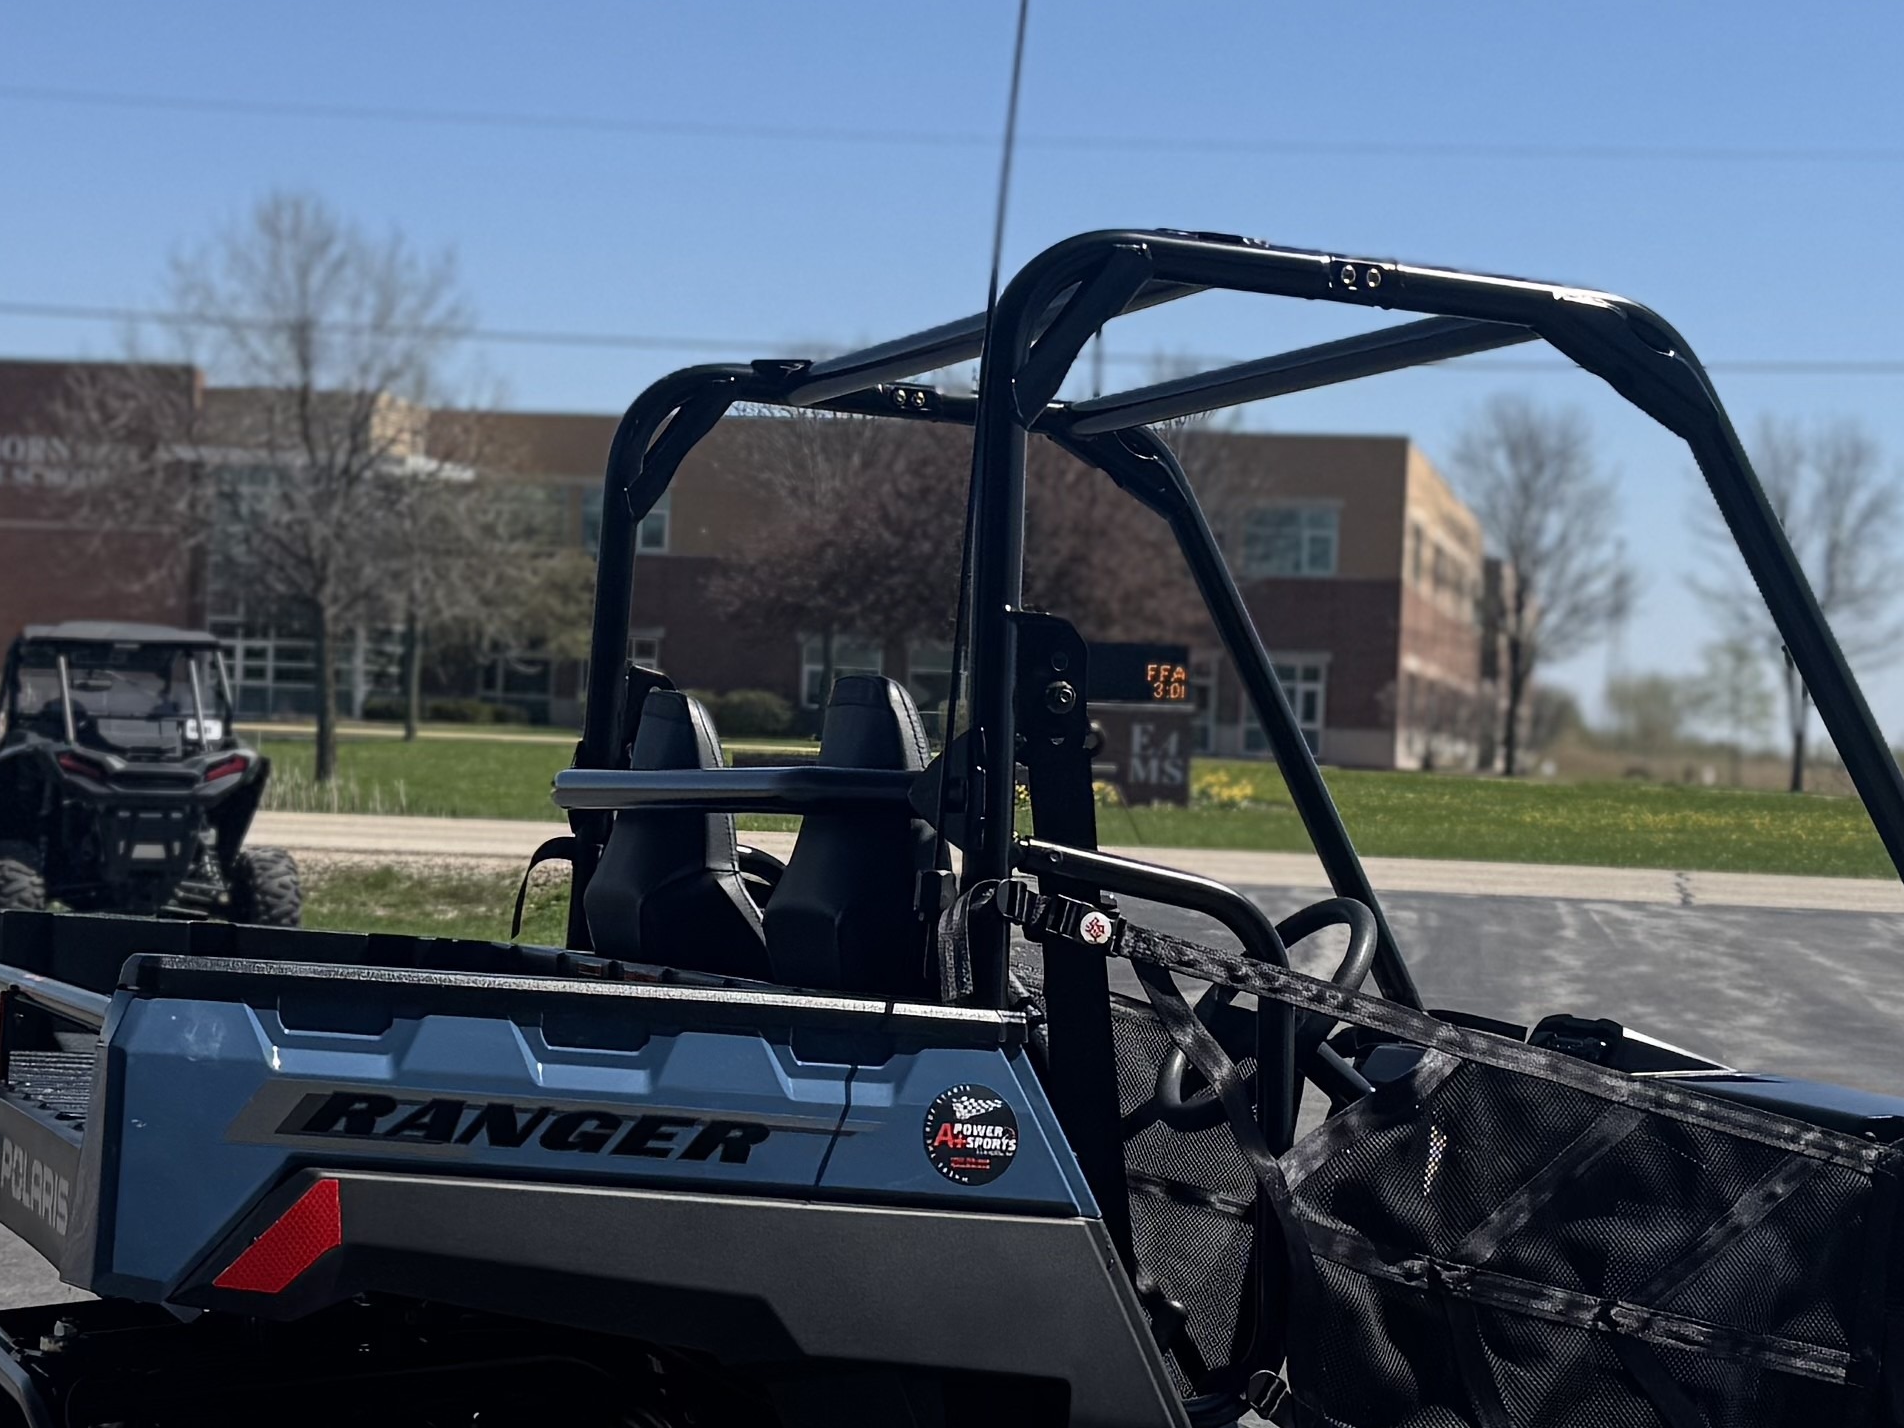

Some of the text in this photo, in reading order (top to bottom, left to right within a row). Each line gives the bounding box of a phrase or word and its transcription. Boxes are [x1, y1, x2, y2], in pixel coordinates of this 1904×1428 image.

[1147, 664, 1186, 682] FFA
[1153, 681, 1186, 699] 3:01
[1128, 756, 1184, 785] MS
[301, 1090, 770, 1165] RANGER
[934, 1122, 1005, 1149] A+ POWER
[965, 1135, 1017, 1152] SPORTS
[0, 1137, 70, 1237] POLARIS
